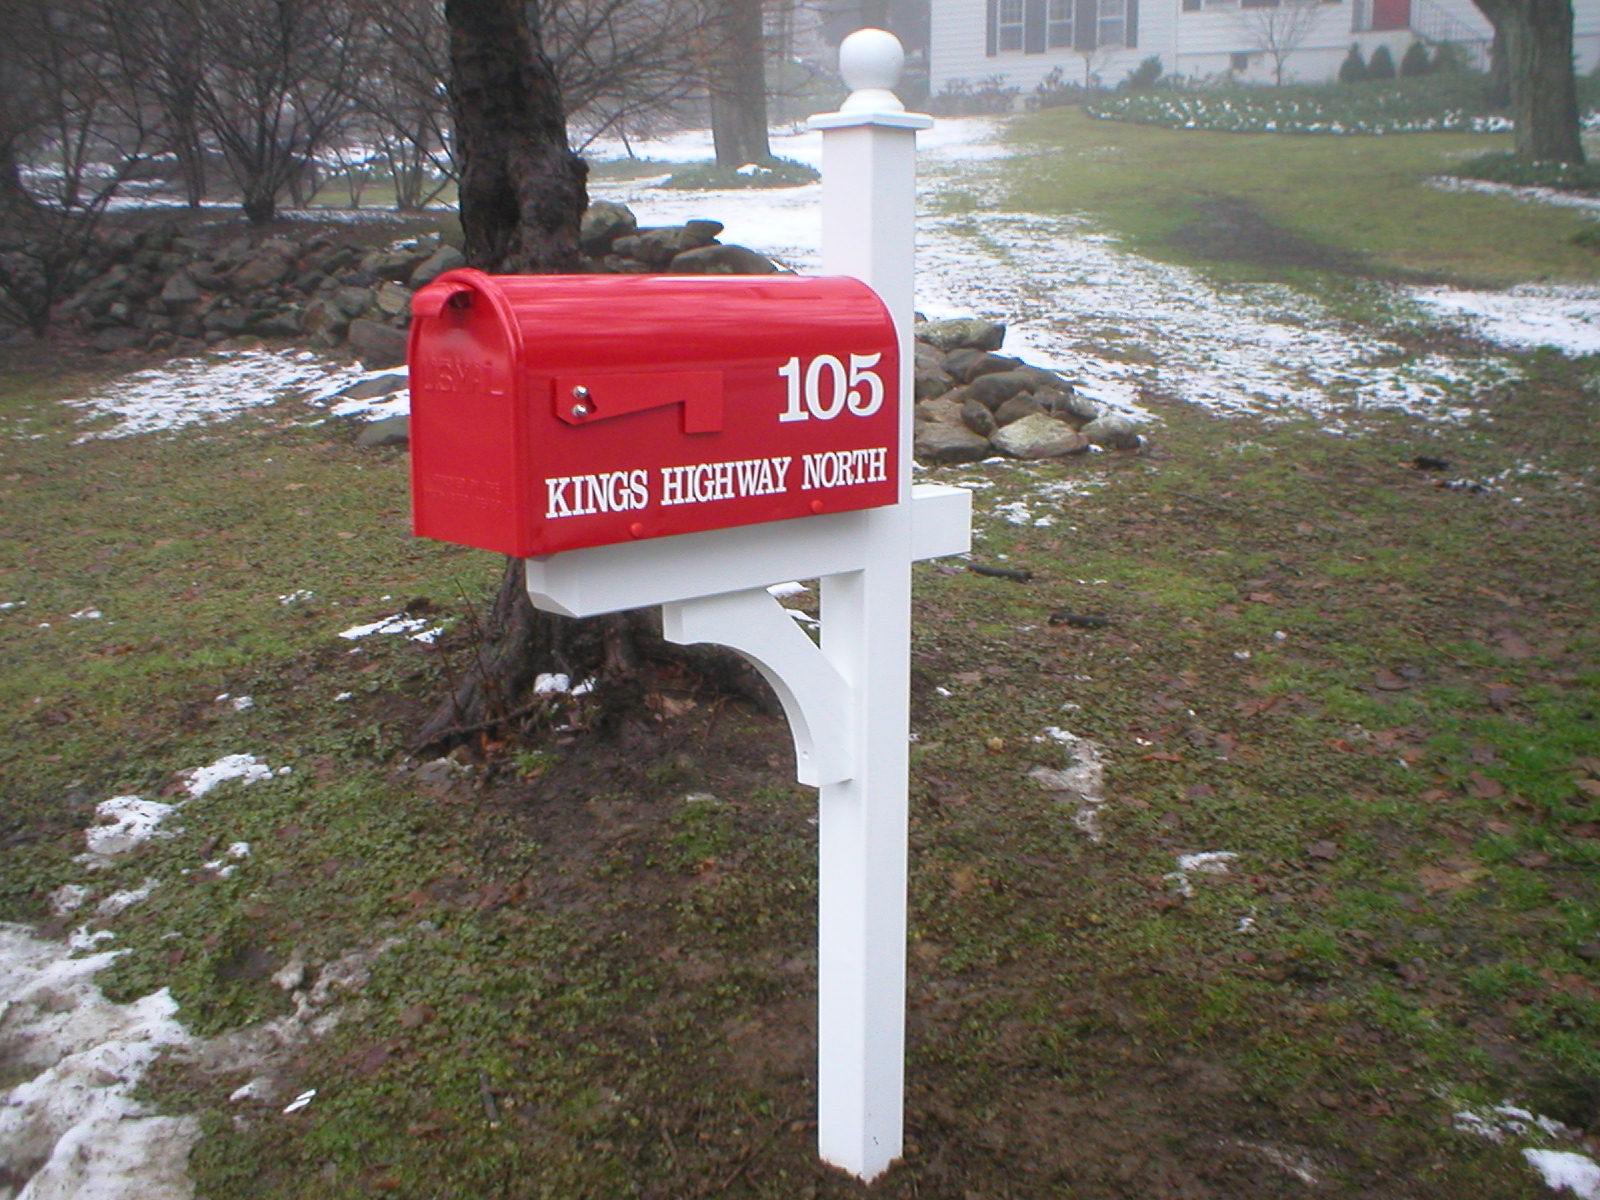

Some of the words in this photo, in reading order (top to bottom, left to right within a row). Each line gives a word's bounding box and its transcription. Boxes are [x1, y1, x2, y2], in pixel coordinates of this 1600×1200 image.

[778, 352, 884, 422] 105
[545, 469, 648, 519] KINGS
[660, 456, 791, 506] HIGHWAY
[801, 447, 887, 490] NORTH
